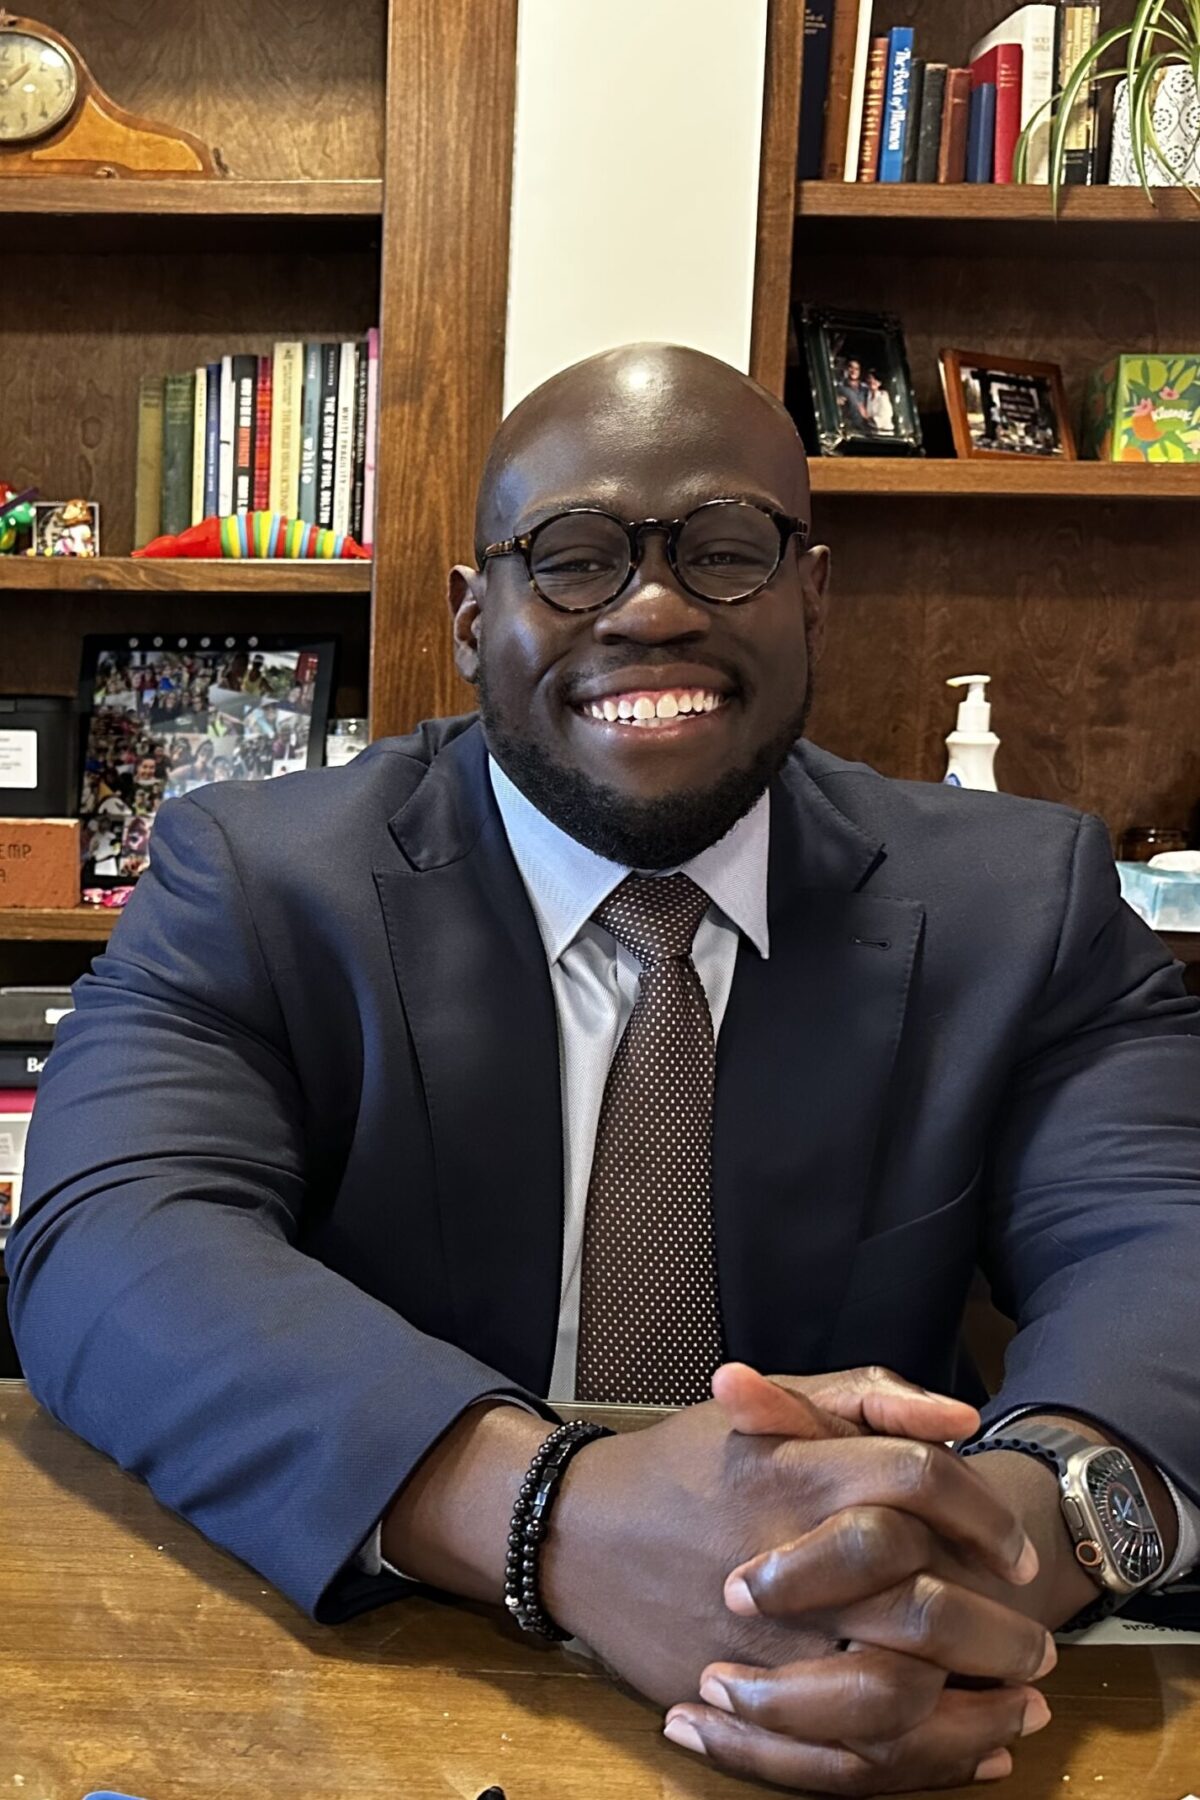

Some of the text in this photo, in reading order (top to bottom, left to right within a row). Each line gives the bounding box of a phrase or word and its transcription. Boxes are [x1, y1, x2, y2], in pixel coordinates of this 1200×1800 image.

[888, 47, 911, 151] The Book of Mormon
[324, 396, 336, 414] THE
[301, 437, 315, 484] white
